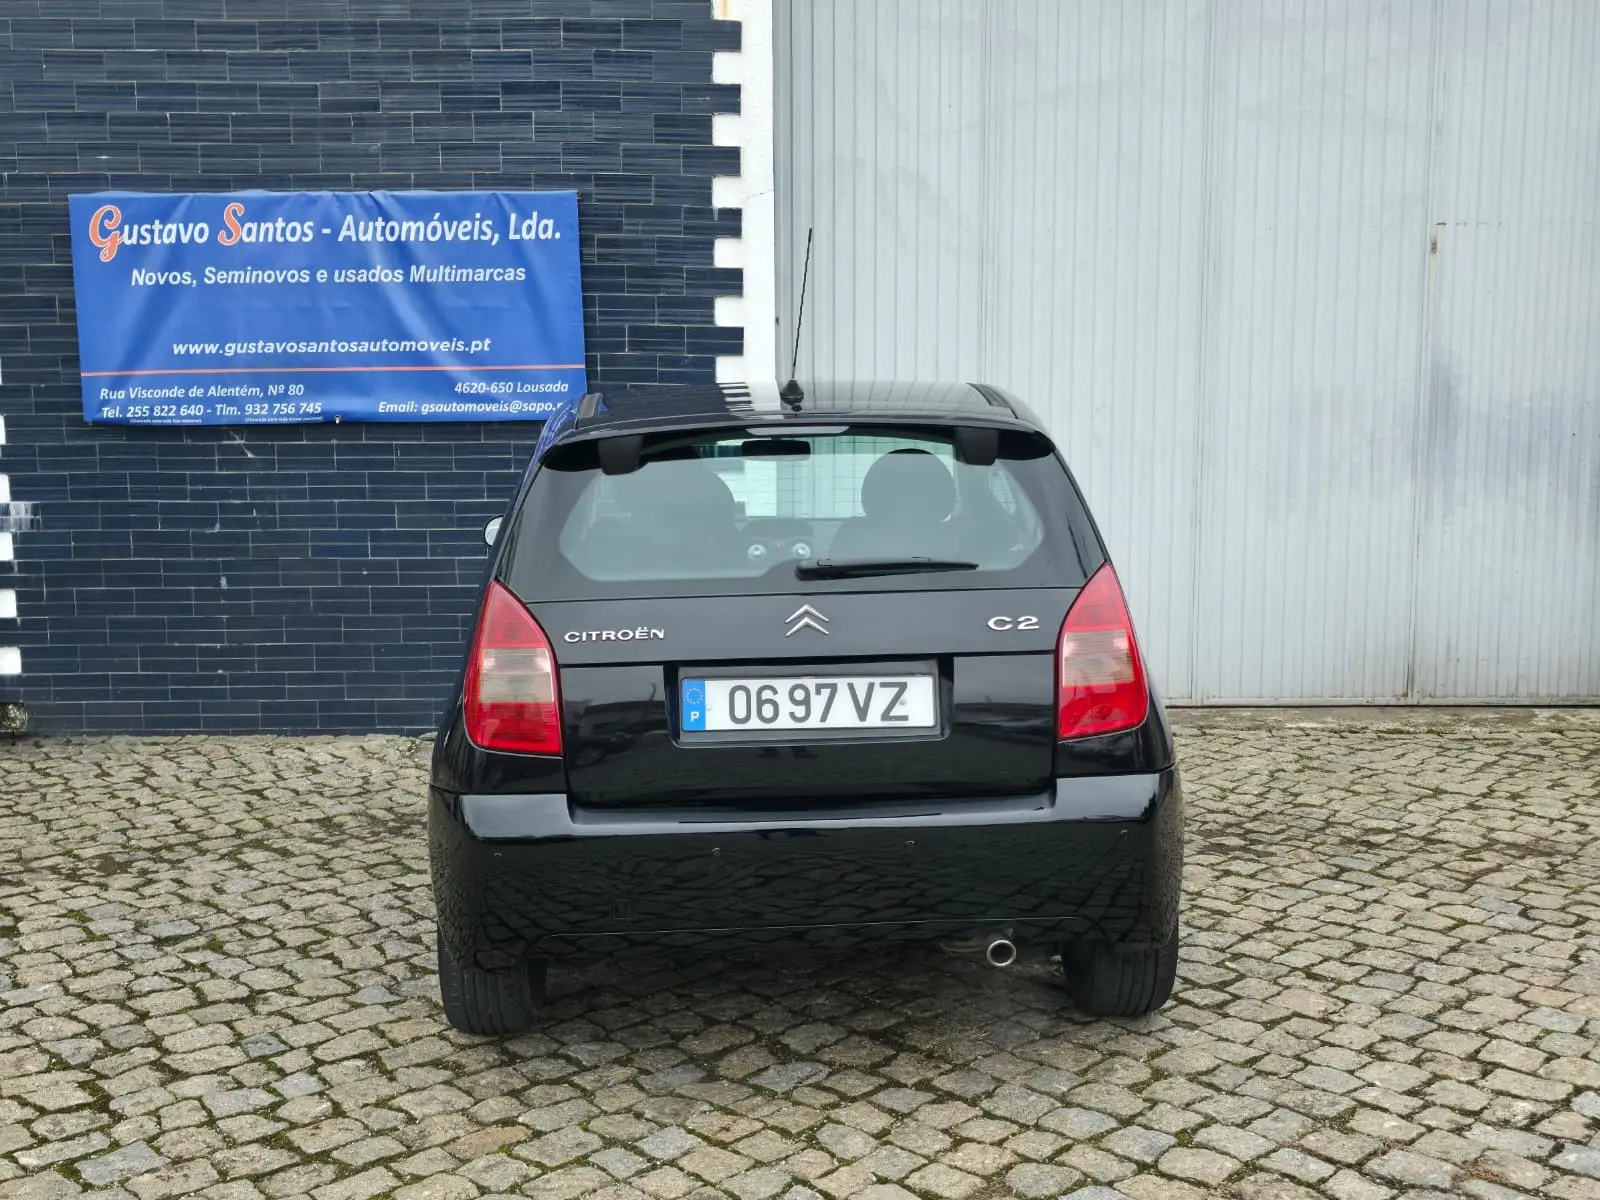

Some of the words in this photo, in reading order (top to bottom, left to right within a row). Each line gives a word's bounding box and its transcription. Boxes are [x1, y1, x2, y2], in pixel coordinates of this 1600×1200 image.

[89, 205, 209, 262] Gustavo
[217, 202, 314, 245] Santos
[338, 212, 500, 246] Automóveis,
[508, 211, 561, 240] Lda.
[131, 268, 197, 287] Novos,
[203, 266, 310, 284] Seminovos
[316, 269, 328, 283] e
[333, 265, 404, 283] usados
[409, 265, 526, 283] Multimarcas
[172, 337, 491, 356] www.gustavosantosautomoveis.pt
[99, 388, 126, 400] Rua
[129, 386, 185, 399] Visconde
[188, 385, 204, 398] de
[207, 384, 264, 398] Alentém,
[287, 384, 305, 396] 80
[454, 382, 513, 394] 4620-650
[517, 380, 569, 393] Lousada
[101, 405, 123, 418] Tel.
[126, 406, 150, 418] 255
[153, 405, 177, 417] 822
[180, 404, 204, 416] 640
[244, 403, 269, 415] 932
[272, 403, 296, 415] 756
[299, 402, 322, 414] 745
[378, 401, 417, 413] Email:
[986, 615, 1039, 631] C2
[564, 626, 665, 643] CITROËN
[690, 711, 699, 722] P
